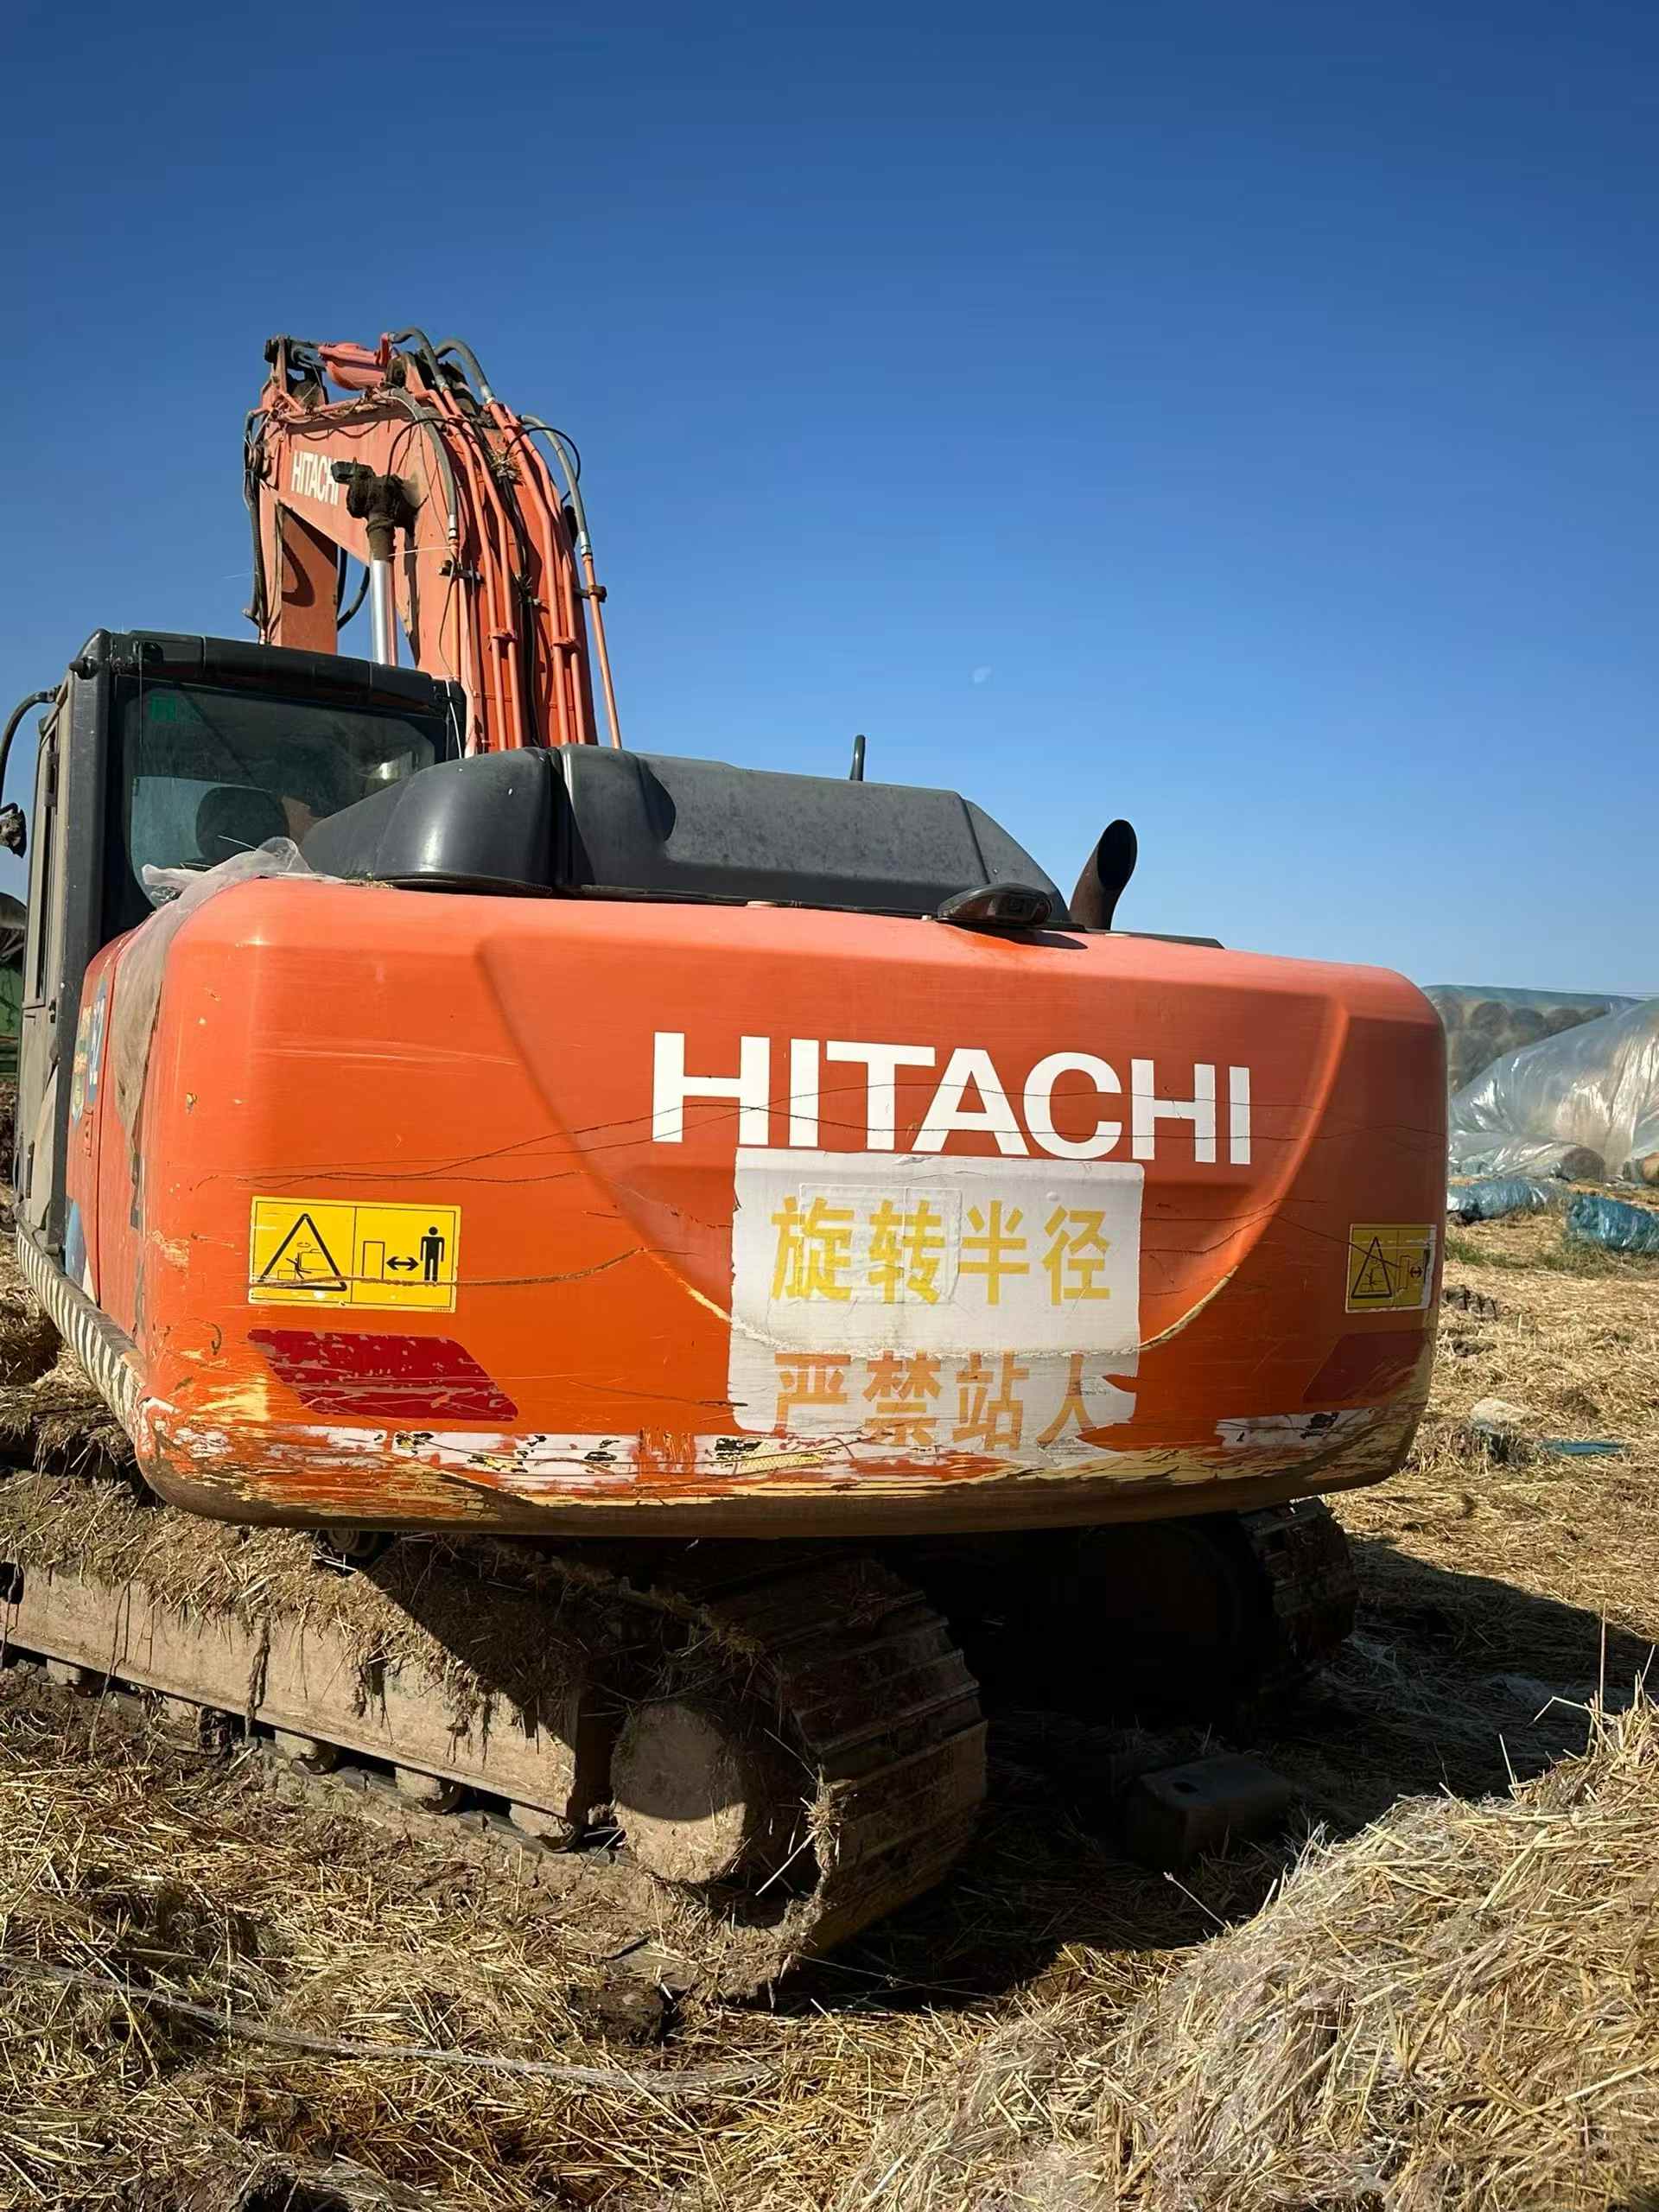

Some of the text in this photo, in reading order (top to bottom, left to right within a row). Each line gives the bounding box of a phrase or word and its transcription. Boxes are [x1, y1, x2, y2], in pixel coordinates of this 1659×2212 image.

[652, 1031, 1251, 1165] HITACHI
[771, 1196, 1110, 1305] 旋转半径
[774, 1351, 1098, 1452] 严禁站人
